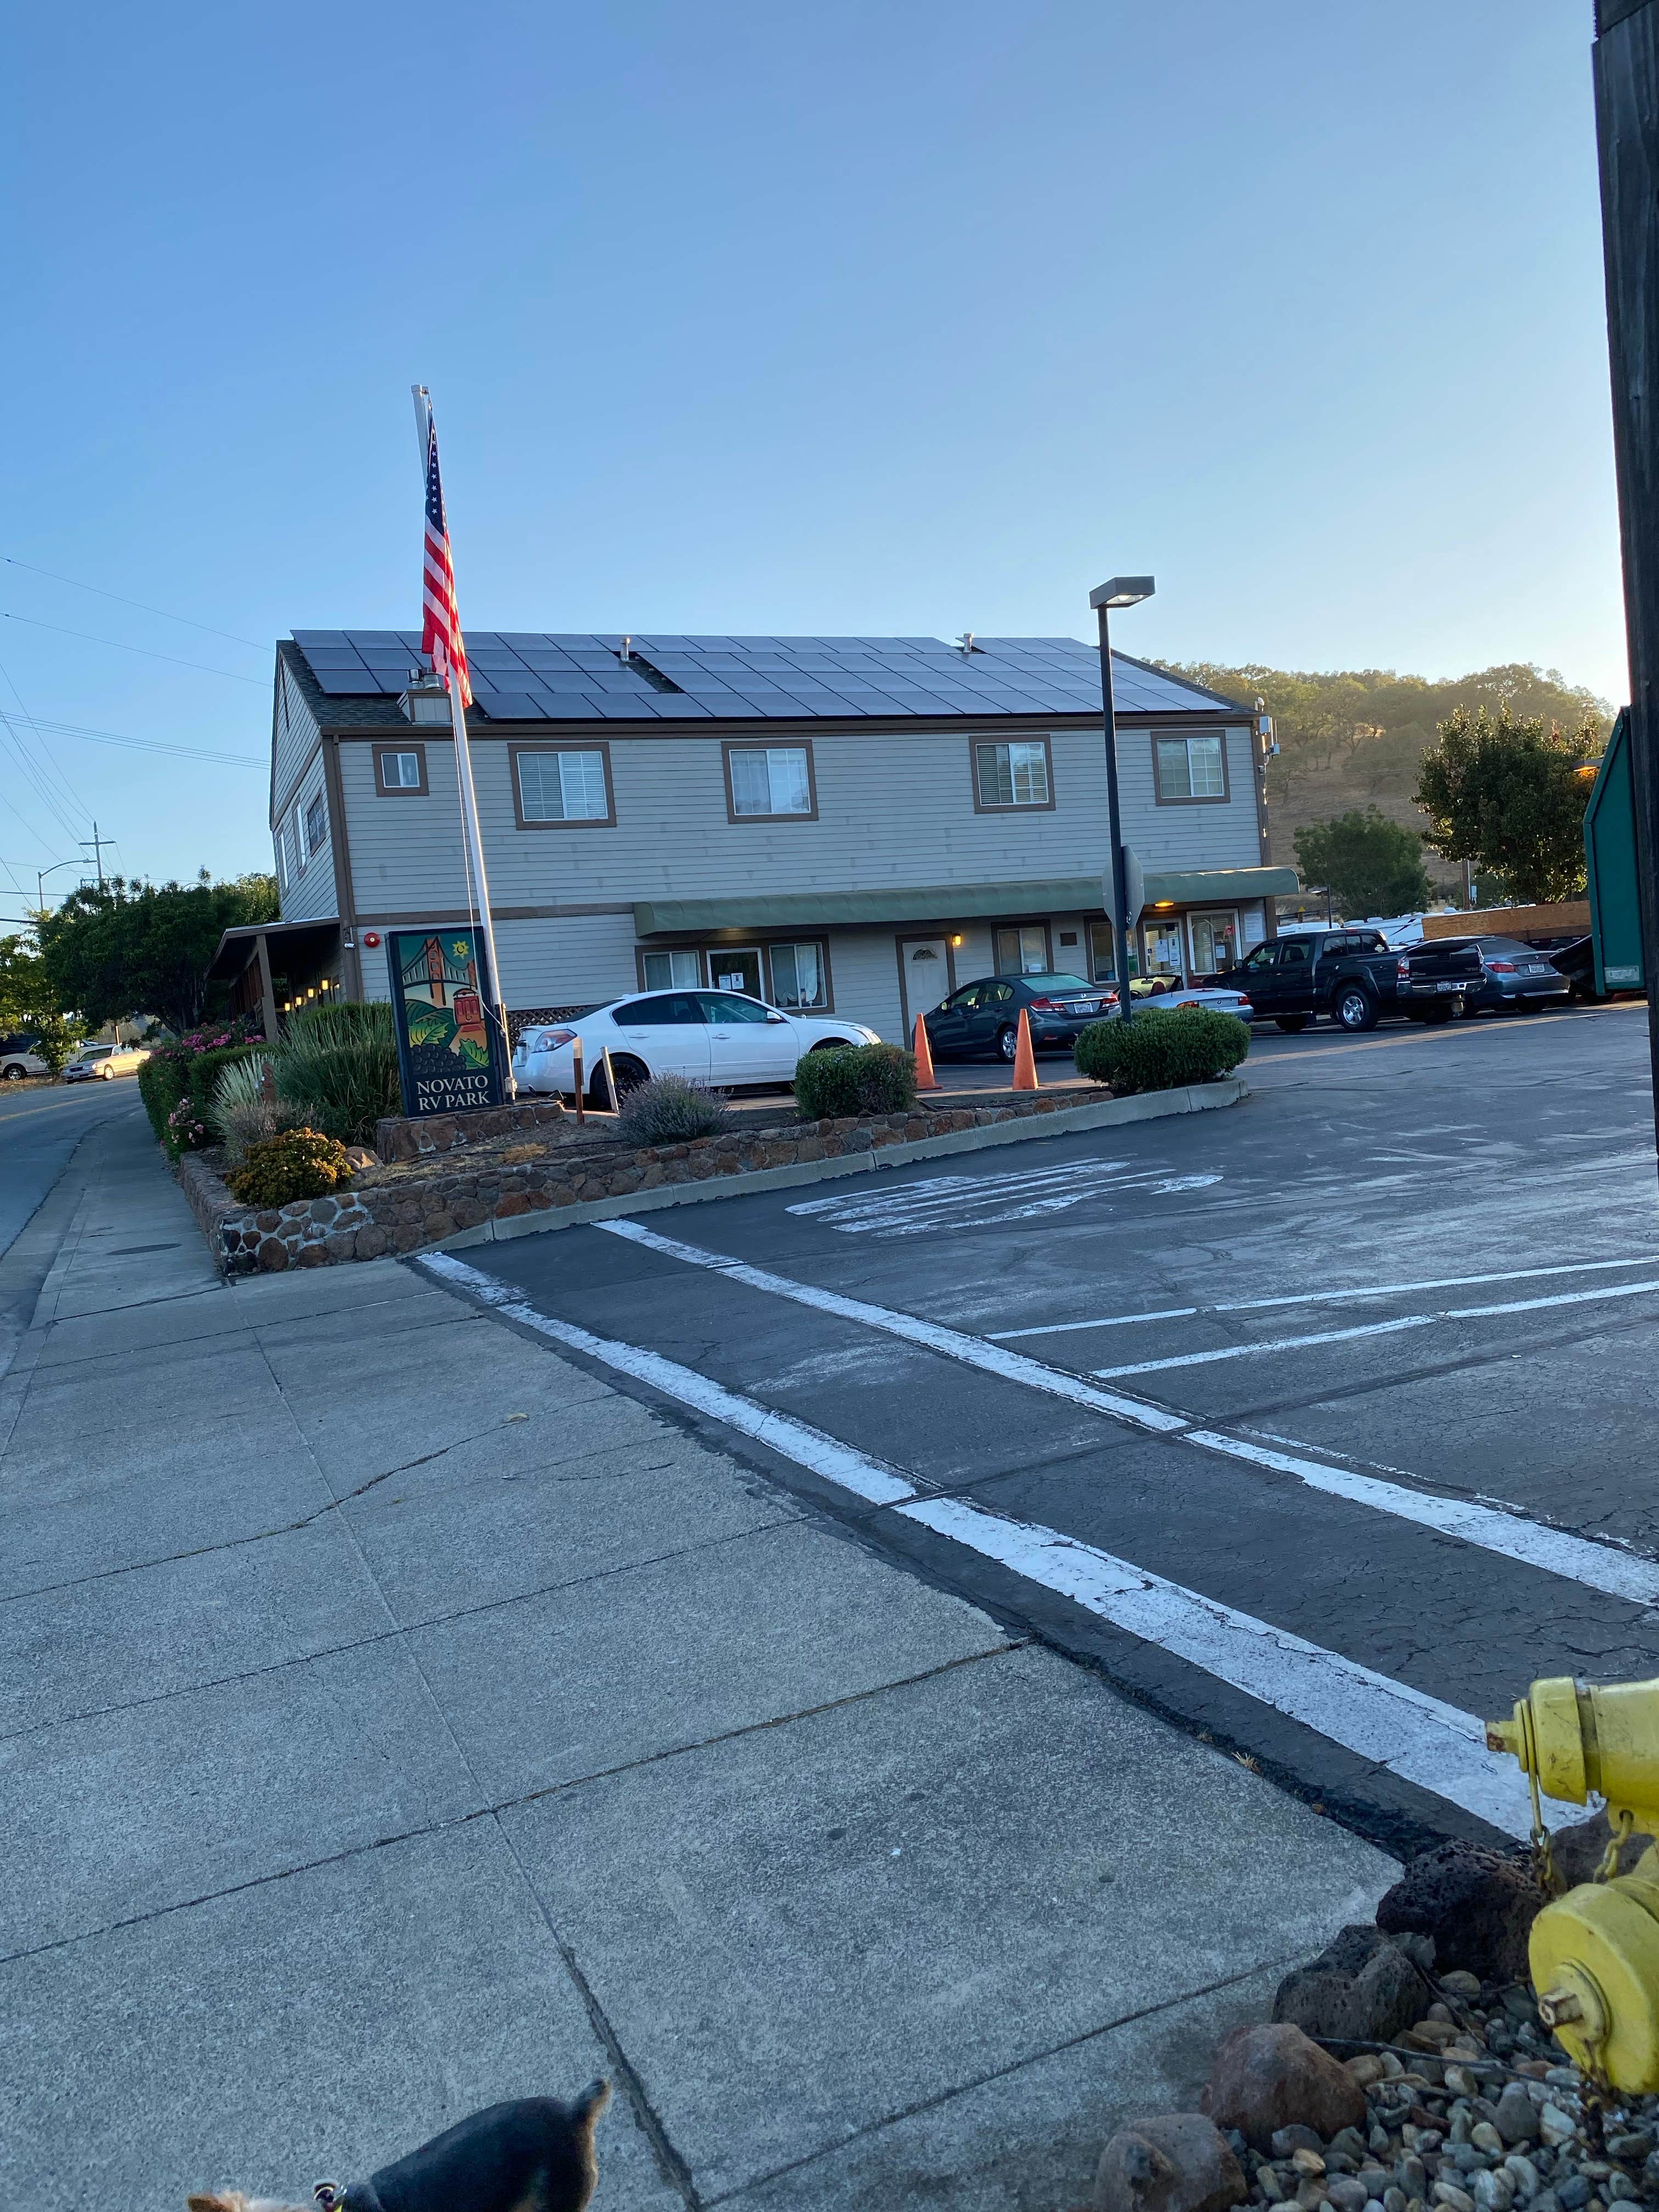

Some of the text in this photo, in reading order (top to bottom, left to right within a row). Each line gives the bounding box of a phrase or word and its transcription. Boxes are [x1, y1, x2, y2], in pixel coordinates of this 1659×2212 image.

[417, 1075, 488, 1094] NOVATO
[419, 1091, 490, 1110] RV PARK
[785, 1153, 1224, 1238] STOP
